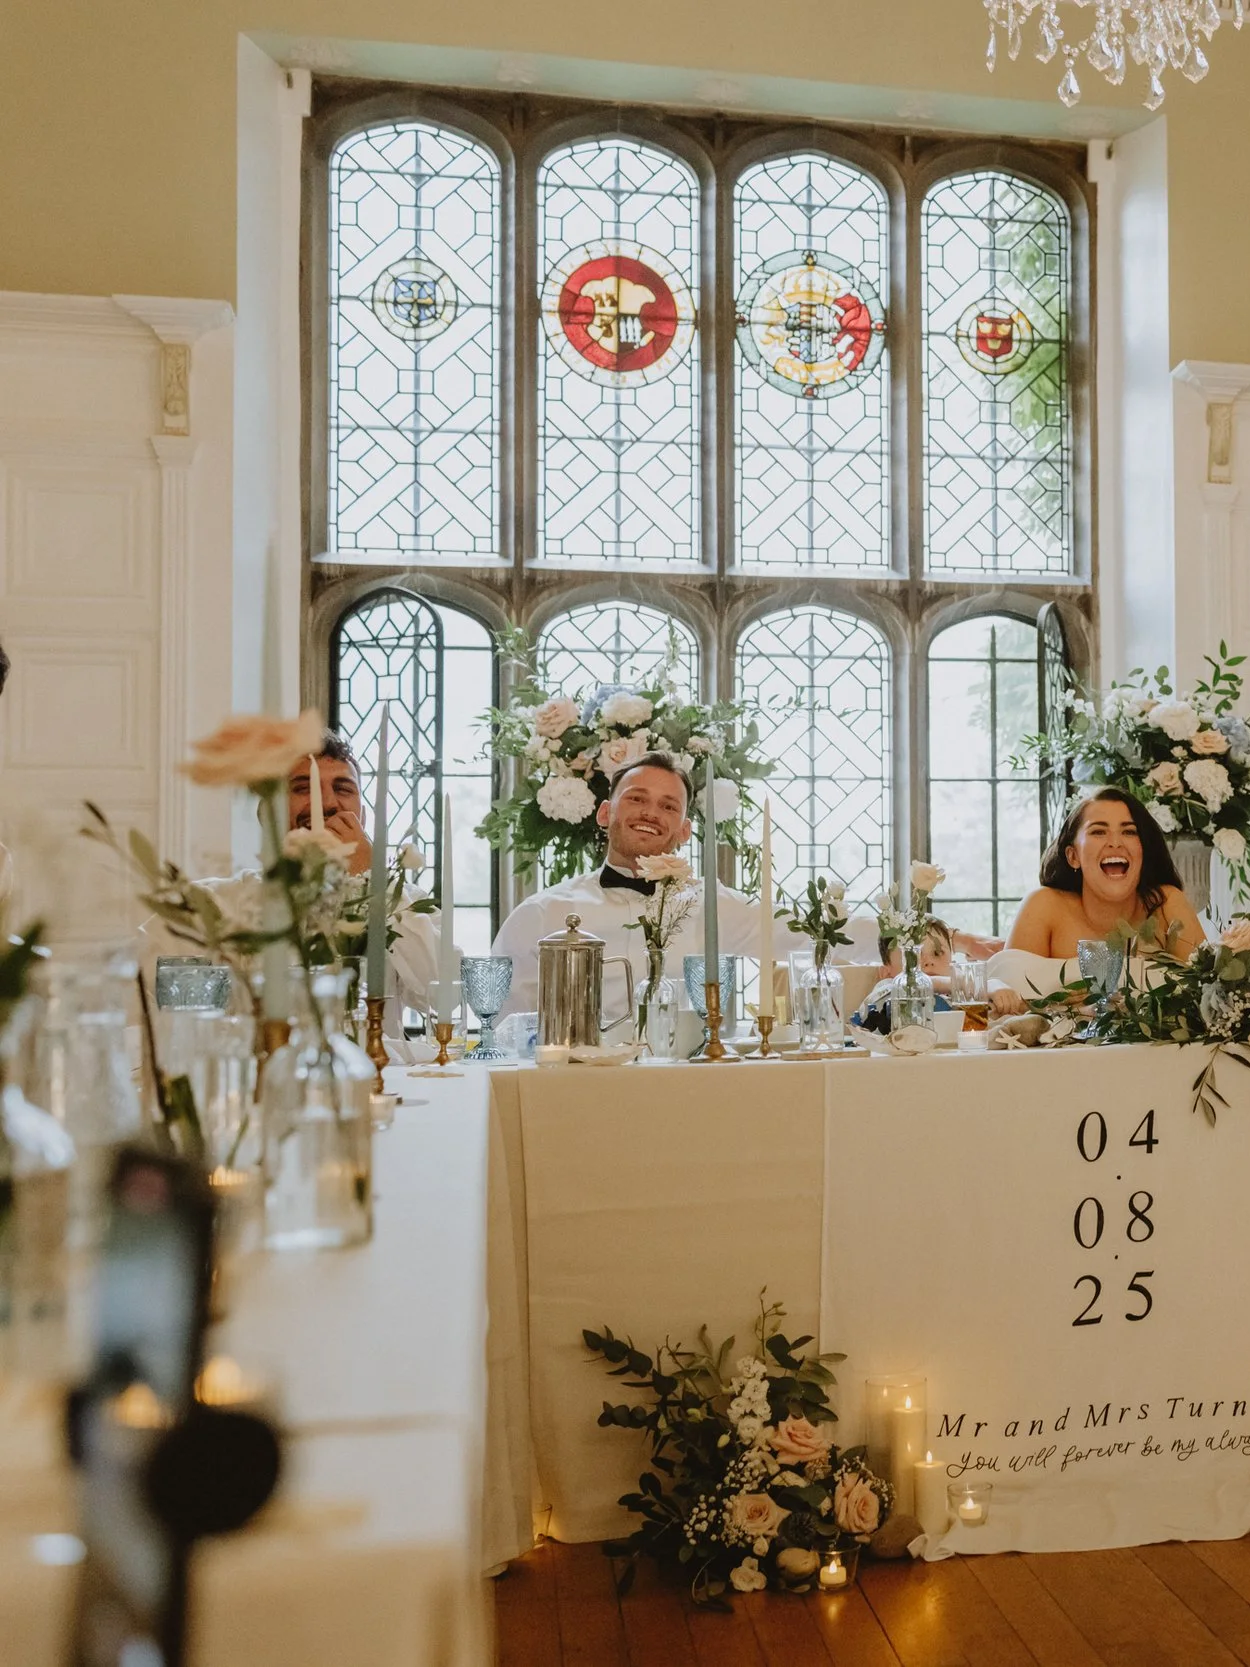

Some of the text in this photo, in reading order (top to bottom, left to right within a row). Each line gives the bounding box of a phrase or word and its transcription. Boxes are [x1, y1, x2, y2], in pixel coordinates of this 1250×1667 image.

[1076, 1108, 1160, 1163] 04
[1073, 1190, 1155, 1250] 08
[1071, 1269, 1155, 1328] 25
[935, 1413, 989, 1438] Mr
[1004, 1407, 1071, 1438] and
[1083, 1402, 1150, 1429] Mrs
[946, 1450, 1001, 1479] you
[1008, 1444, 1058, 1473] will
[1060, 1440, 1136, 1473] forever
[1140, 1434, 1164, 1457] be
[1170, 1437, 1200, 1462] my
